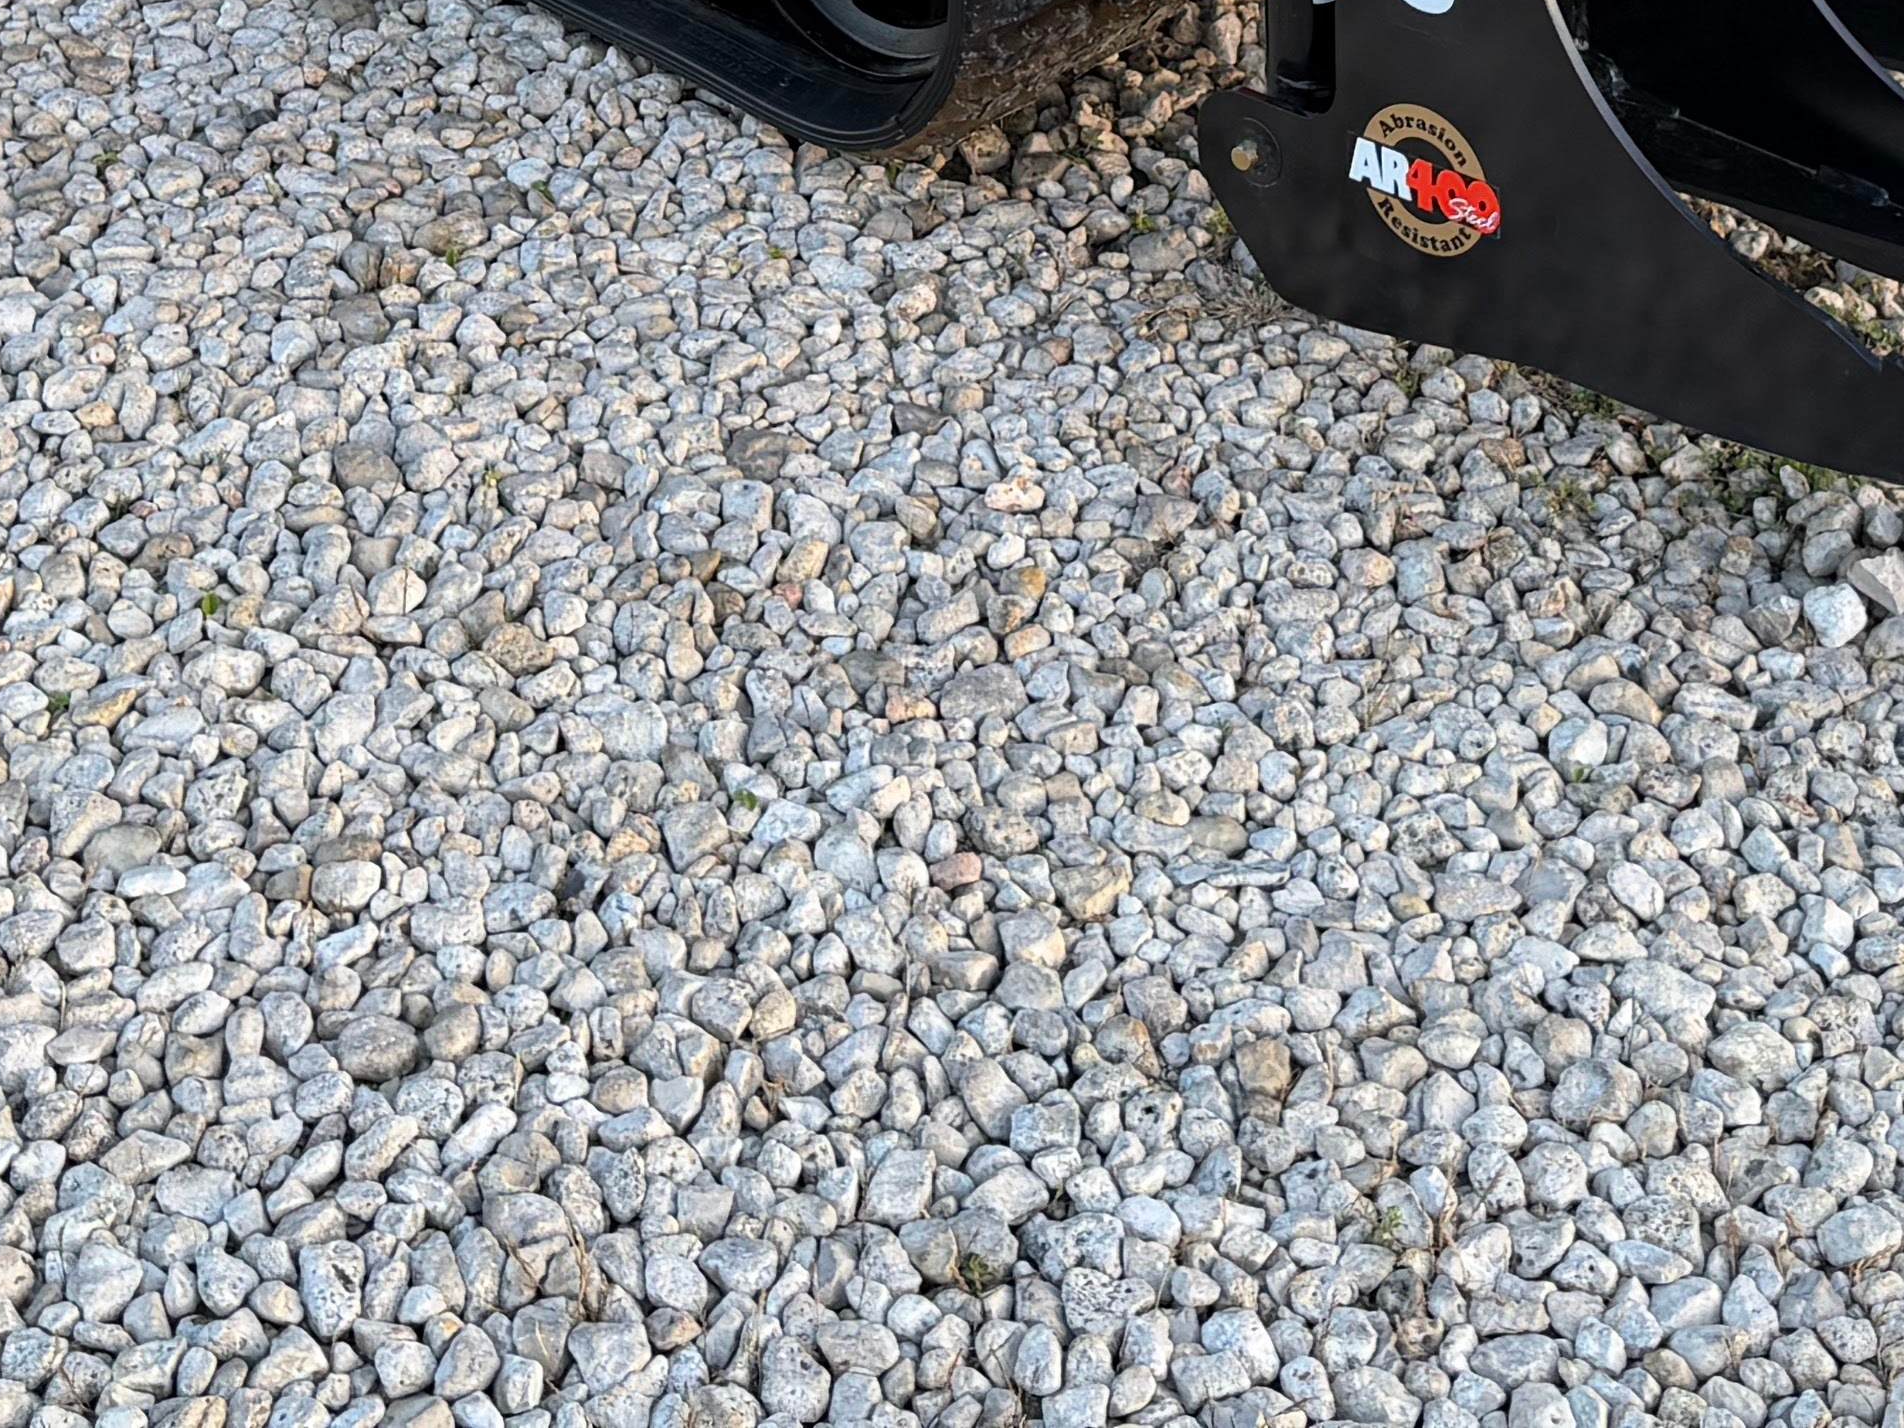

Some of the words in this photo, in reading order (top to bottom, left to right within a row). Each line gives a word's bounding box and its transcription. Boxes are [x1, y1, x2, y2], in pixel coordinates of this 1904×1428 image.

[1378, 113, 1468, 168] Abrasion
[1348, 136, 1501, 235] AR400
[1377, 197, 1472, 253] Resistant
